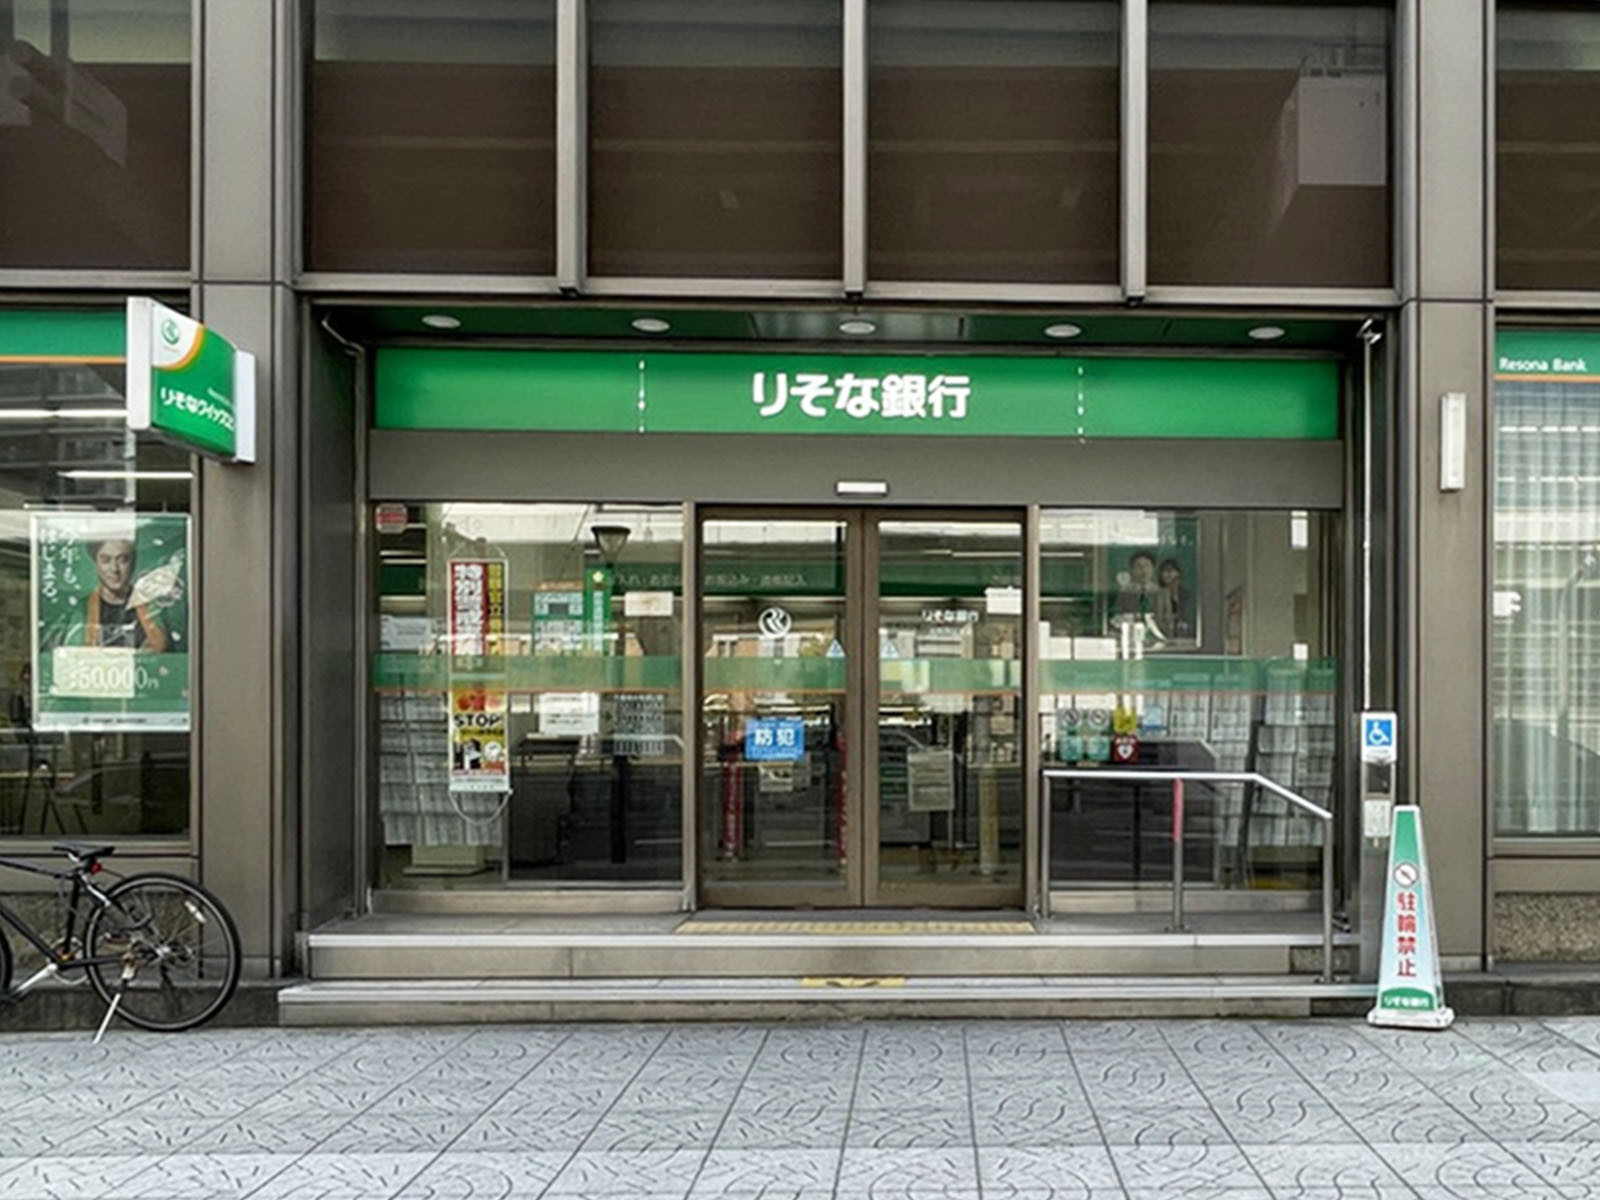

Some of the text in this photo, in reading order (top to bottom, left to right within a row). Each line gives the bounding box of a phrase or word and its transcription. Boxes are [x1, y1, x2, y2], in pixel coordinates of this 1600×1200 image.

[1499, 357, 1588, 372] Resona Bank
[752, 372, 971, 418] りそな銀行
[754, 727, 795, 747] 防犯
[1396, 891, 1417, 978] 駐輪禁止
